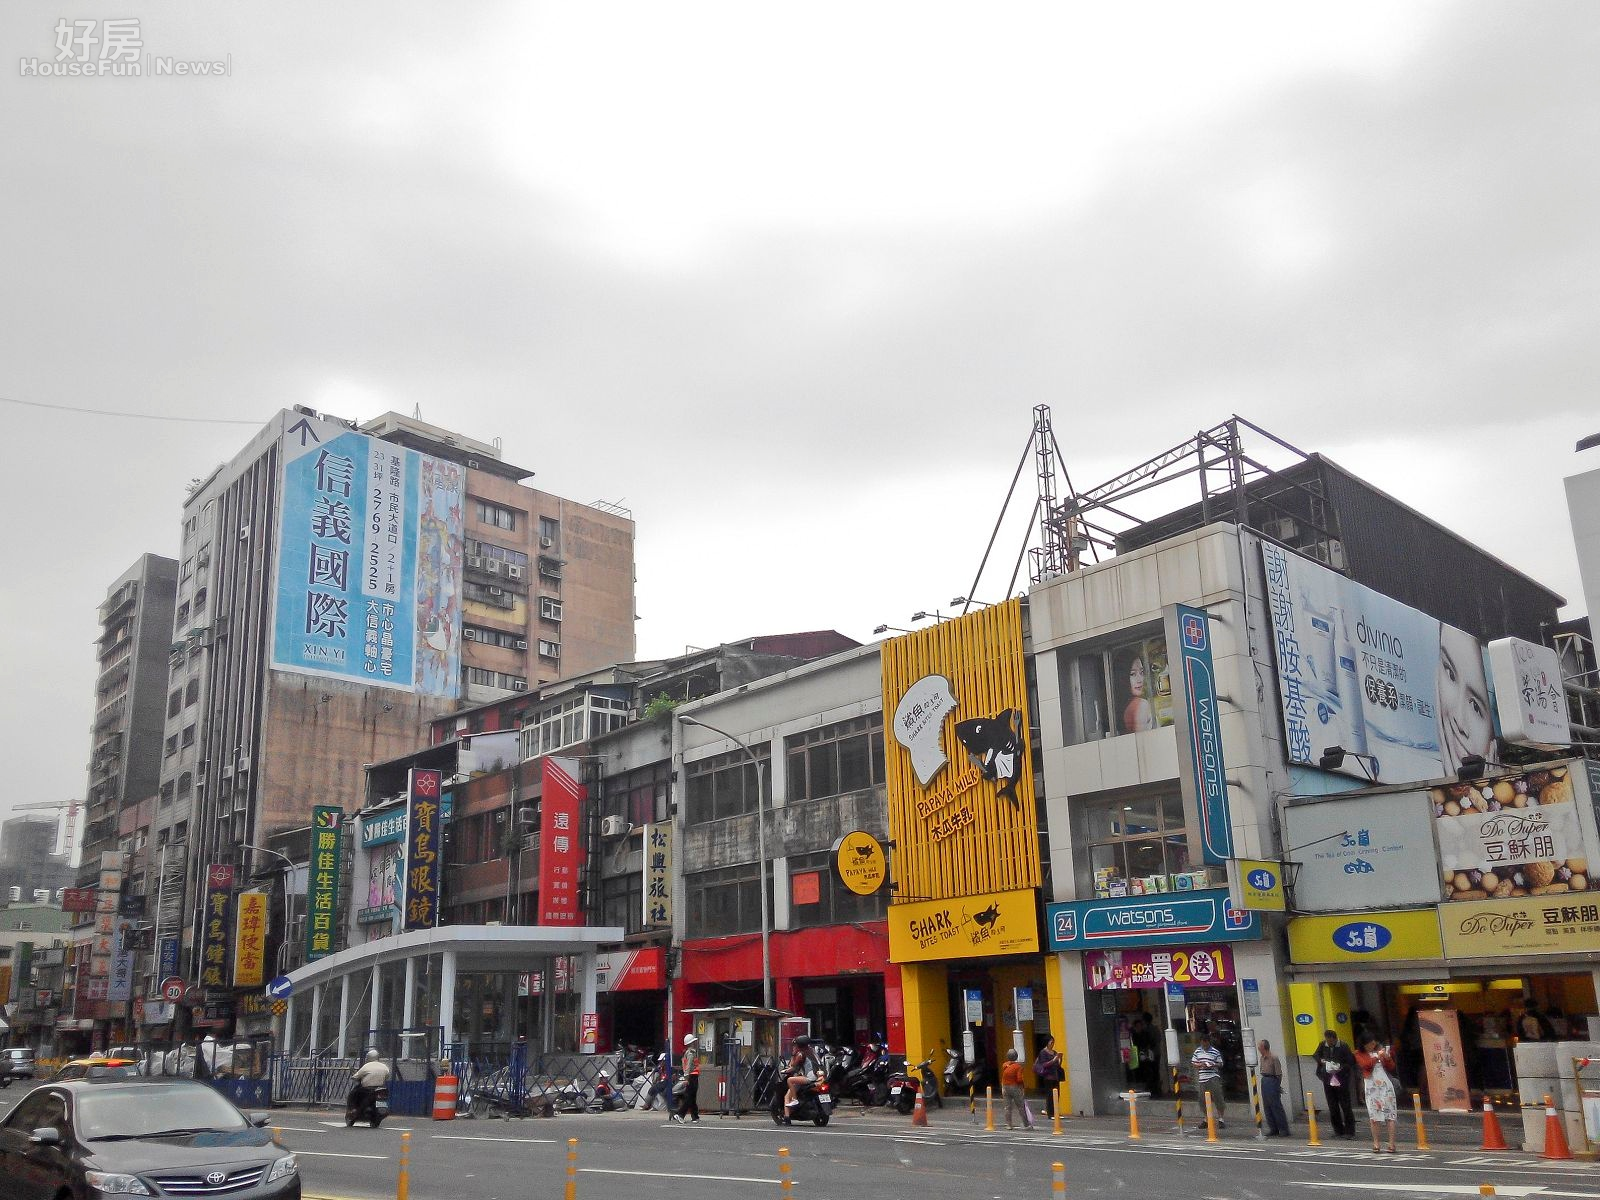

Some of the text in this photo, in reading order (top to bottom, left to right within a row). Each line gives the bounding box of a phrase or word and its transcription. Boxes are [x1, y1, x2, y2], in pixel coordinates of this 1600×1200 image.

[305, 449, 354, 638] 信義國際
[917, 768, 979, 818] PAPAYA MILK
[553, 812, 569, 853] 遠傳
[932, 806, 974, 842] 木瓜牛乳
[408, 801, 437, 925] 寶島眼鏡
[649, 828, 668, 922] 松興旅社
[312, 832, 335, 951] 勝佳生活百貨
[909, 909, 952, 941] SHARK
[920, 926, 960, 949] BITES TOAST
[1058, 918, 1073, 932] 24
[1346, 926, 1377, 949] 50嵐
[168, 987, 180, 997] 30
